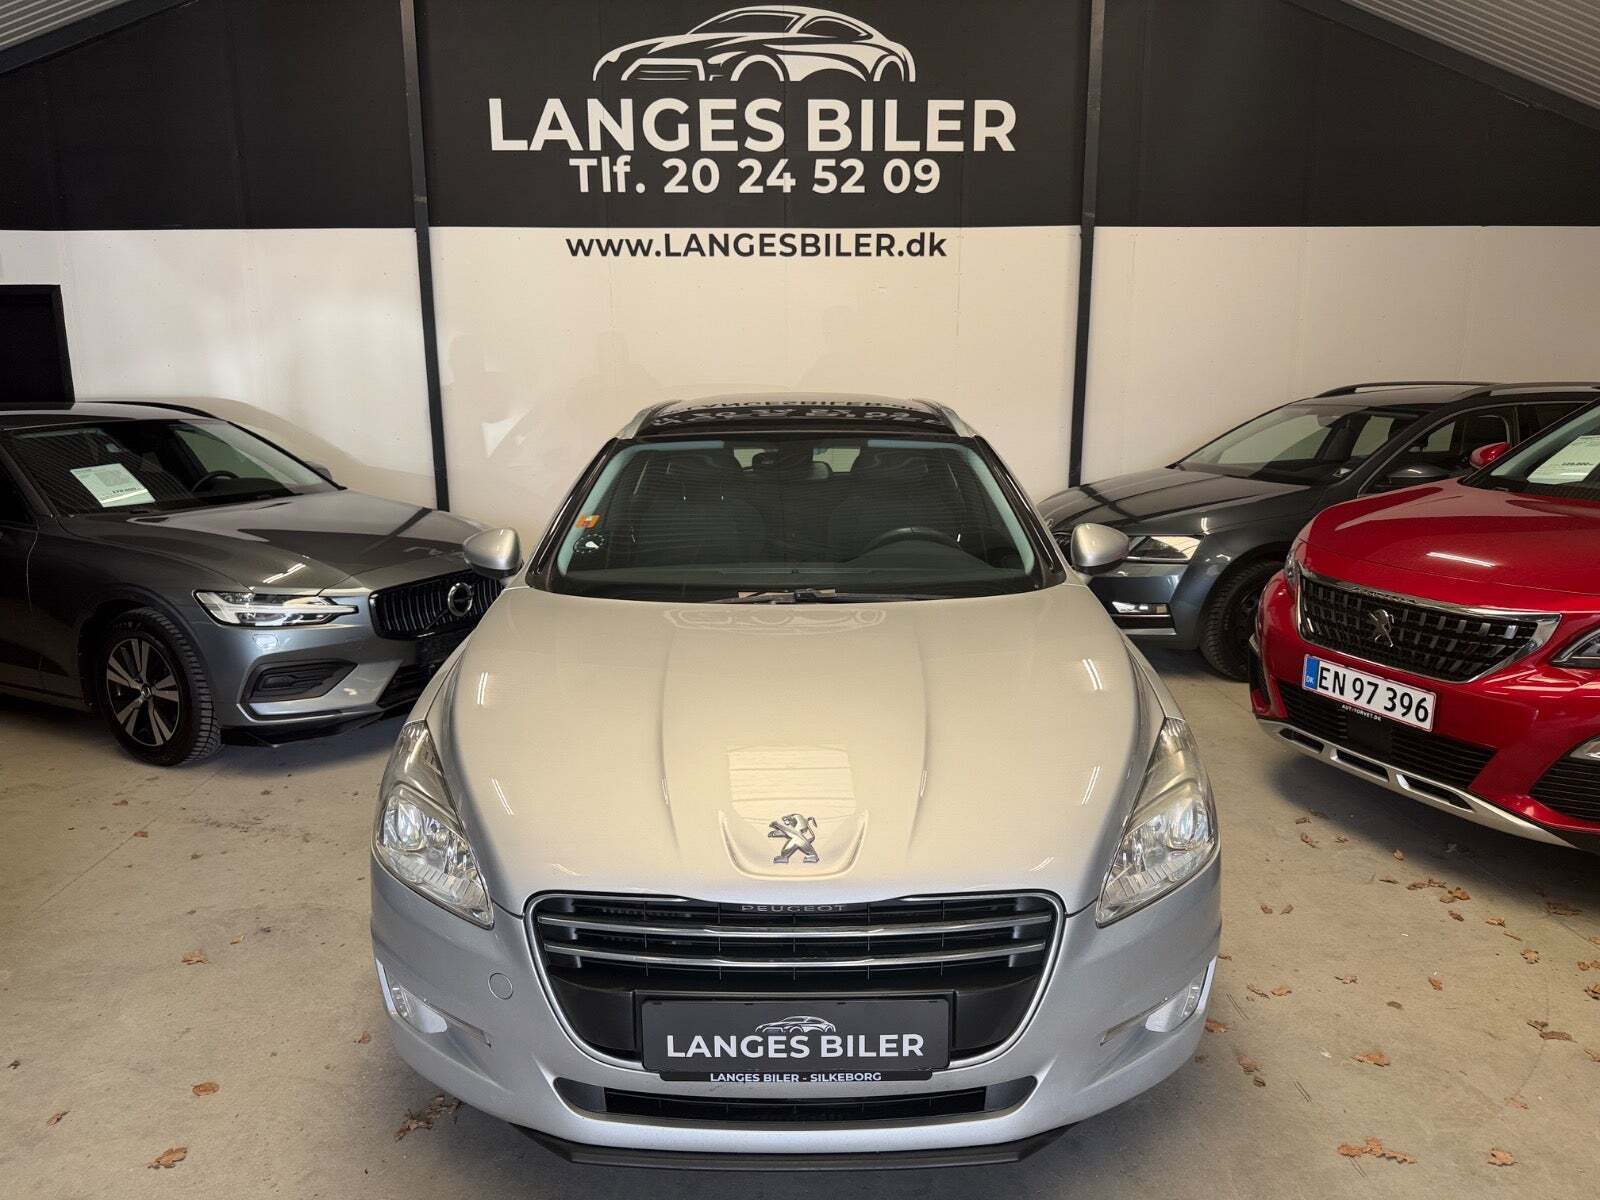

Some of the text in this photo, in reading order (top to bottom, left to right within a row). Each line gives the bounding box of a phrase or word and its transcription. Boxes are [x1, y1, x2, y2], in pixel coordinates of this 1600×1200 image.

[488, 97, 1017, 152] LANGES BILER
[569, 155, 941, 193] Tlf. 20 24 52 09
[566, 232, 947, 257] www.LANGESBILER.dk
[1306, 675, 1315, 684] DK
[1319, 667, 1429, 722] EN 97 396
[740, 904, 847, 912] PEUGEOT
[666, 1033, 924, 1059] LANGES BILER
[710, 1073, 760, 1082] LANGES
[763, 1073, 799, 1083] BILER
[810, 1072, 882, 1082] SILKEBORG
